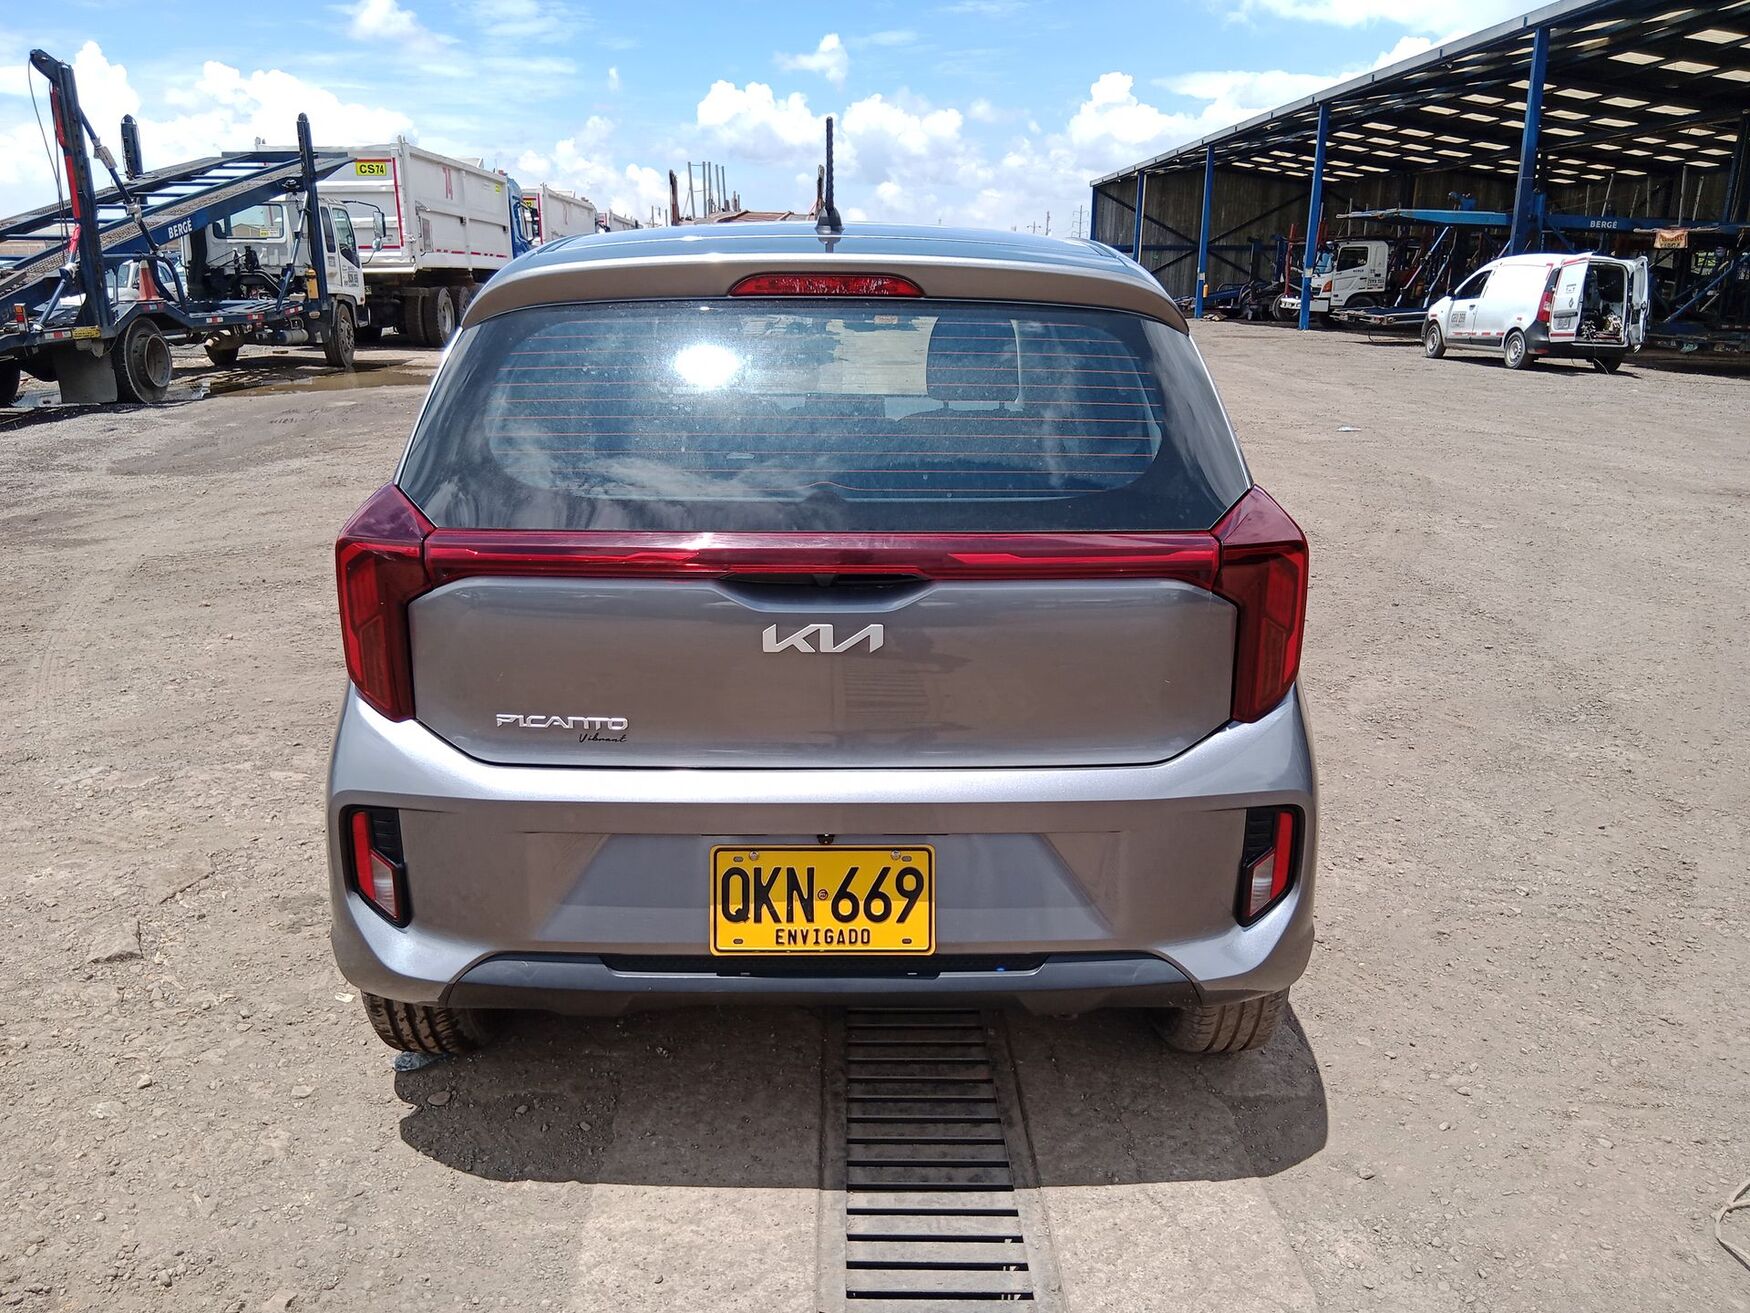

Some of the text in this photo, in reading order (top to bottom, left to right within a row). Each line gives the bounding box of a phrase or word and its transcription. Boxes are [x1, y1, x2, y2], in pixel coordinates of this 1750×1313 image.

[359, 164, 385, 174] CS74
[168, 217, 193, 239] BERGÉ
[762, 623, 884, 653] KIA
[496, 713, 629, 730] PICANTO
[578, 732, 628, 743] Vibrant
[721, 866, 925, 924] QKN 669
[775, 928, 871, 945] ENVIGADO
